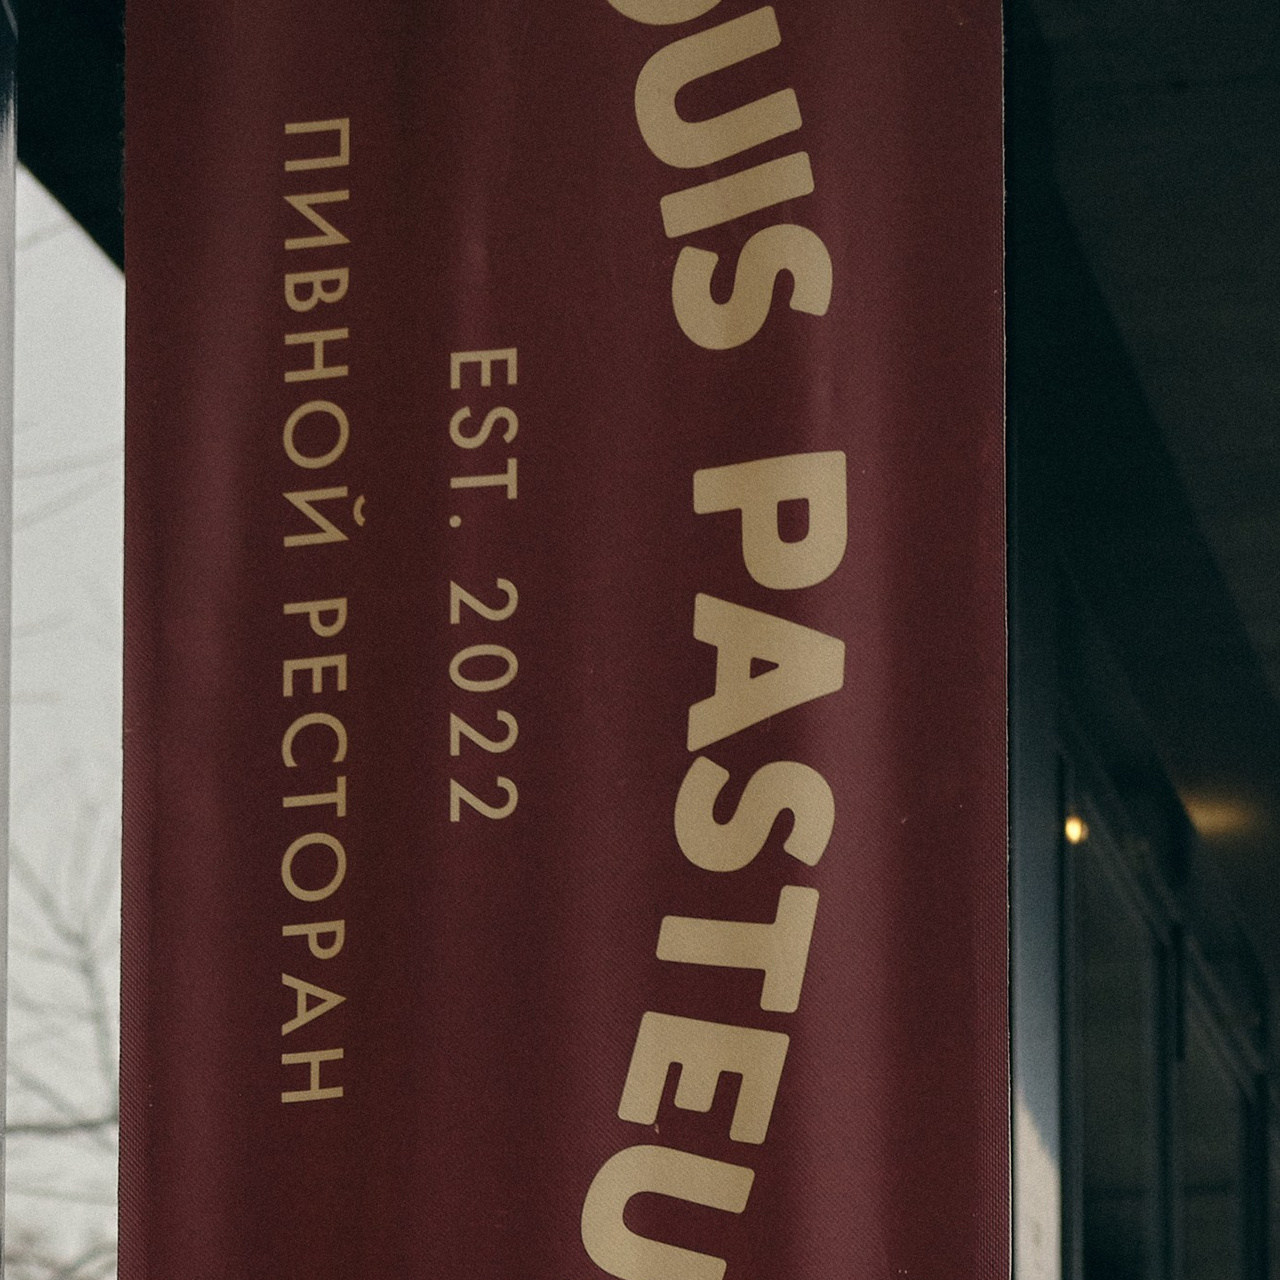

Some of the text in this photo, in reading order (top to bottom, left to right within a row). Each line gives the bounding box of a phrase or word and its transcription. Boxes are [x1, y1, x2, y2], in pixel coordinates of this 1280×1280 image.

[606, 0, 834, 351] UIS
[280, 116, 366, 1104] ПИВНОЙ РЕСТОРАН
[449, 346, 519, 824] EST. 2022
